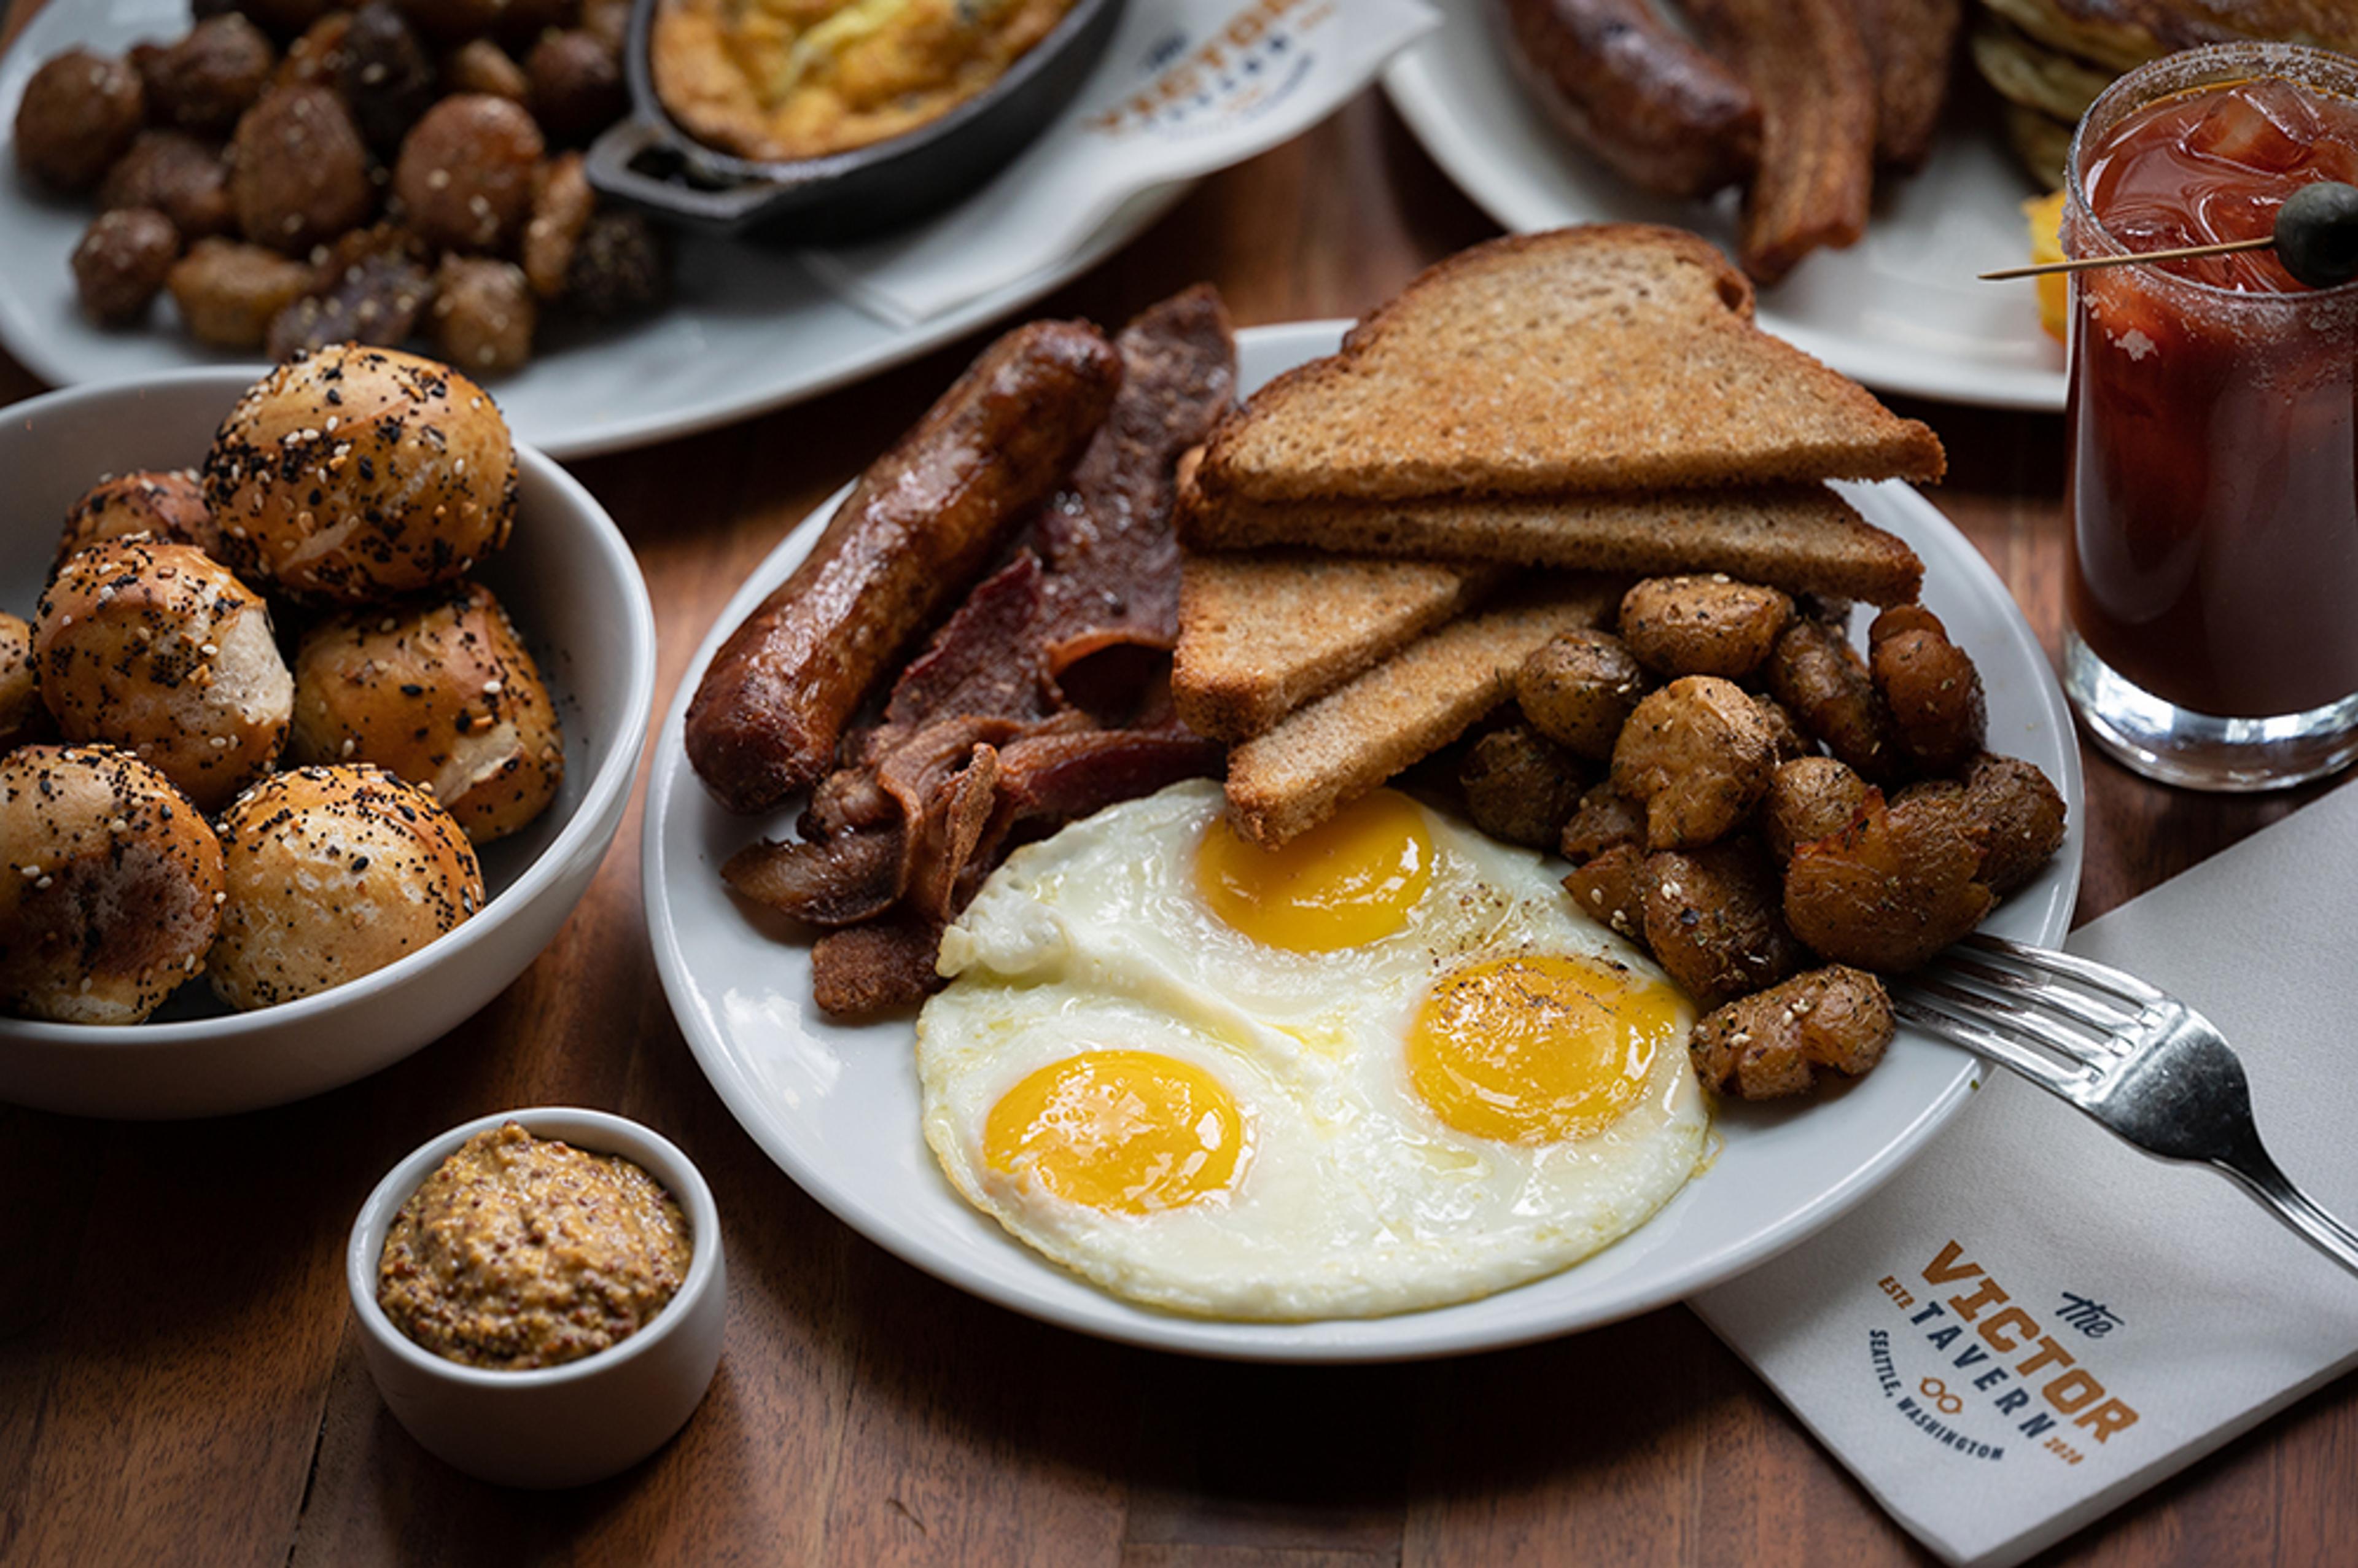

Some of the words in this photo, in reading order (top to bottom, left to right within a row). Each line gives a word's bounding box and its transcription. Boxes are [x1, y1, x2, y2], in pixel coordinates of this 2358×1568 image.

[1910, 1301, 2057, 1438] TAVERN
[1921, 1239, 2139, 1445] VICTOR
[2055, 1291, 2125, 1338] The
[1870, 1330, 1901, 1398] SEATTLE,
[1897, 1395, 2005, 1460] WASHINGTON
